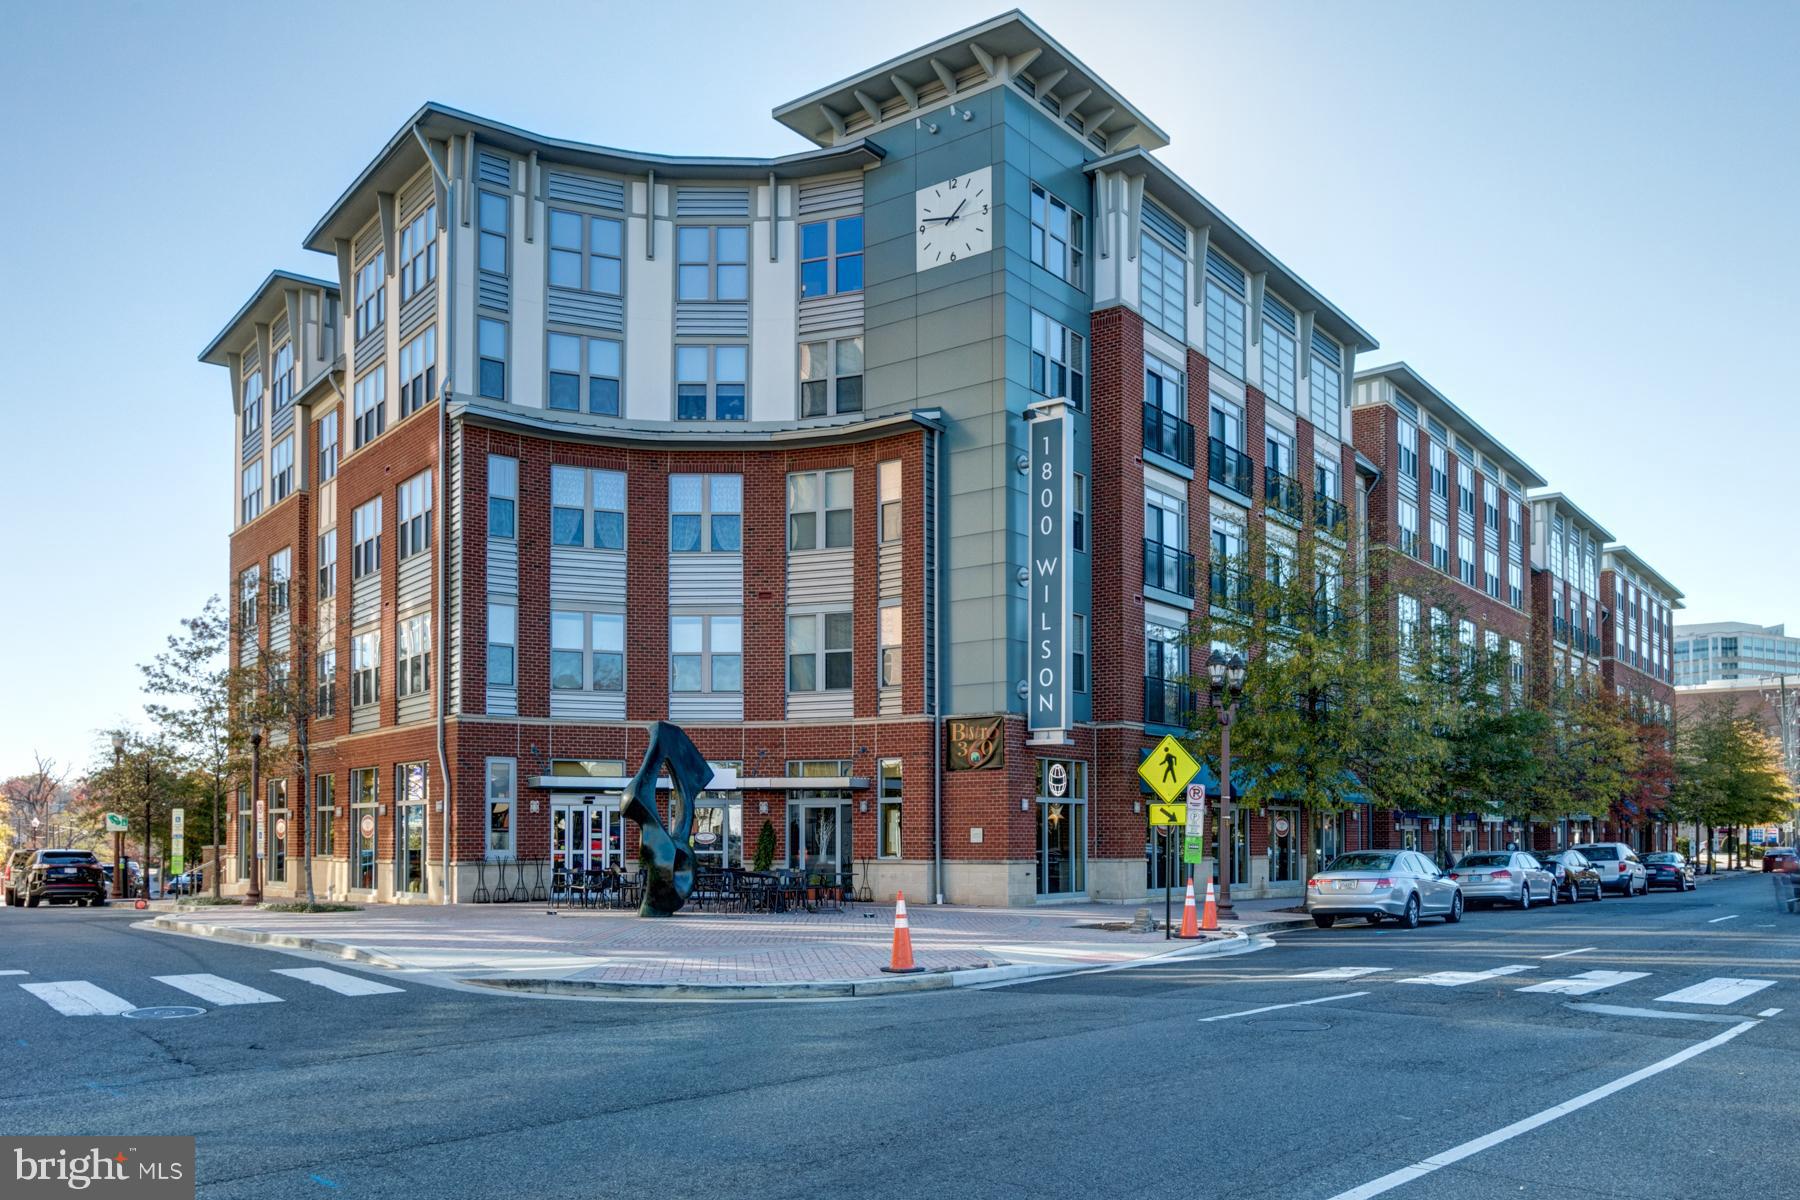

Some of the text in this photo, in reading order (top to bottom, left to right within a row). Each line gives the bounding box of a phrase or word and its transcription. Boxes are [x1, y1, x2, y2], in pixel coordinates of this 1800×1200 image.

[948, 178, 958, 190] 12
[981, 204, 989, 216] 3
[919, 225, 926, 235] 9
[950, 251, 957, 262] 6
[1036, 436, 1057, 712] 1800 WILSON
